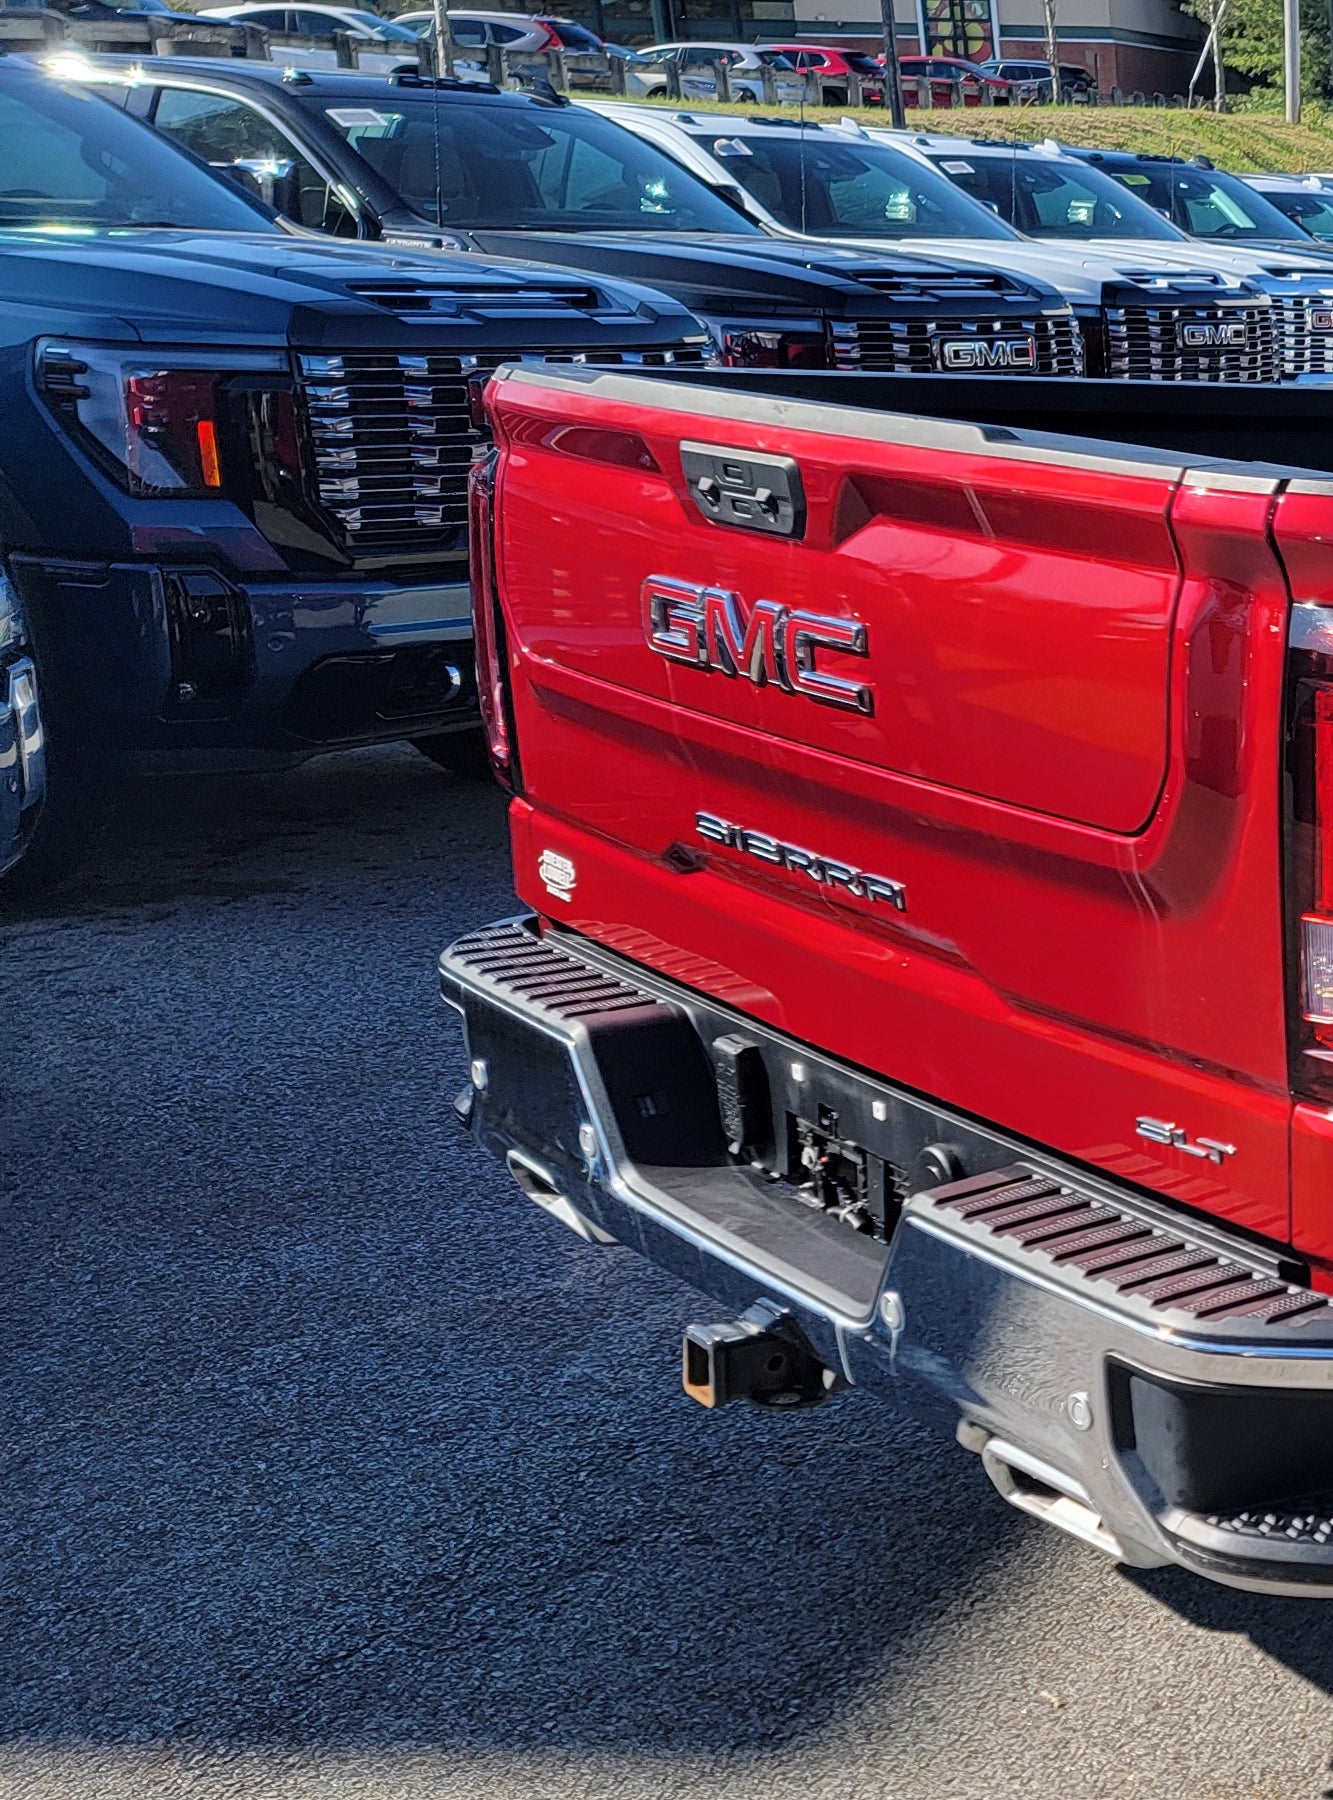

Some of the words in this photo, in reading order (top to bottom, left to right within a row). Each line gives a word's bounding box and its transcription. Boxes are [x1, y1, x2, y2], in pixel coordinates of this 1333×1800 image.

[943, 340, 1034, 368] GMC
[1184, 324, 1246, 346] GMC
[641, 574, 874, 716] GMC
[694, 810, 907, 912] SIERRA
[1135, 1116, 1238, 1165] SLT
